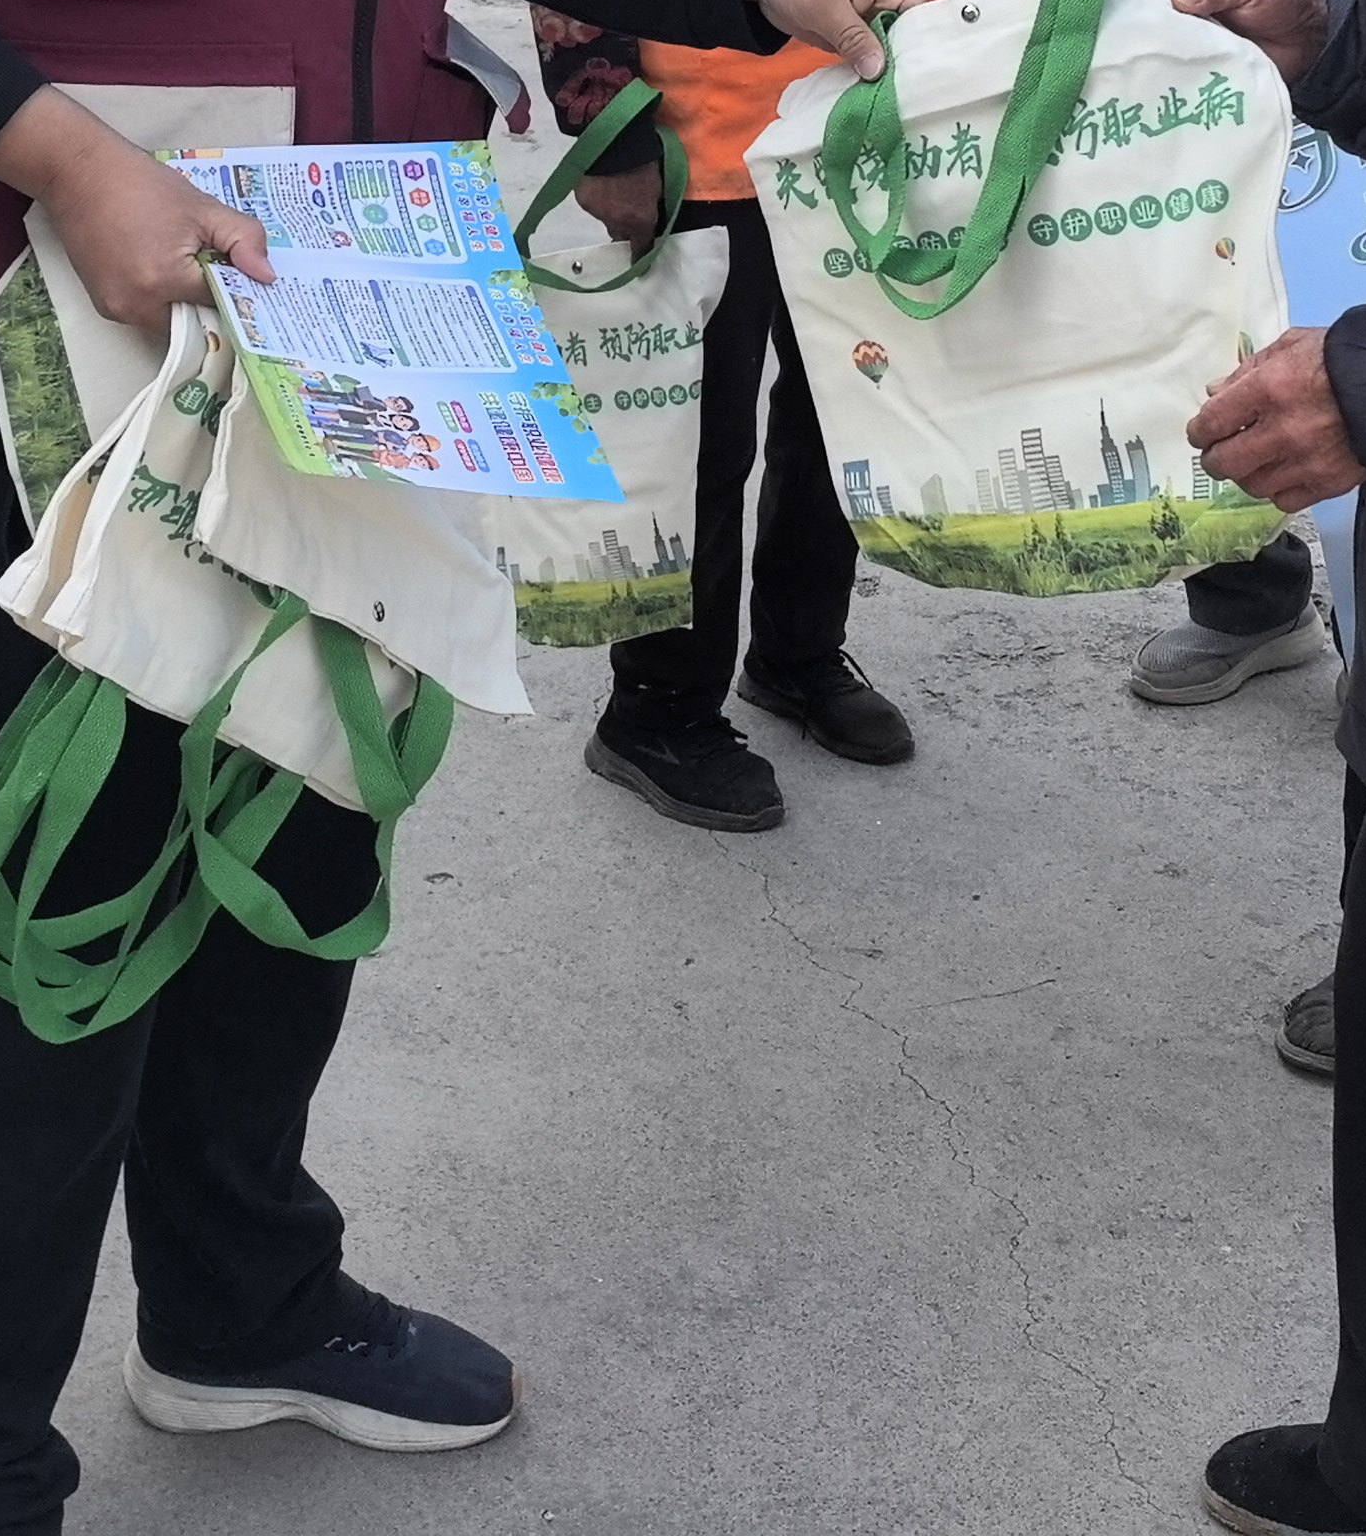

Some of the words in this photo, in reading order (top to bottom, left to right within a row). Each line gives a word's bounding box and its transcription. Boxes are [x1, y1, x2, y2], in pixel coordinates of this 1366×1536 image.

[1029, 181, 1228, 244] 守护职业健康
[508, 391, 565, 484] 守护职业健康
